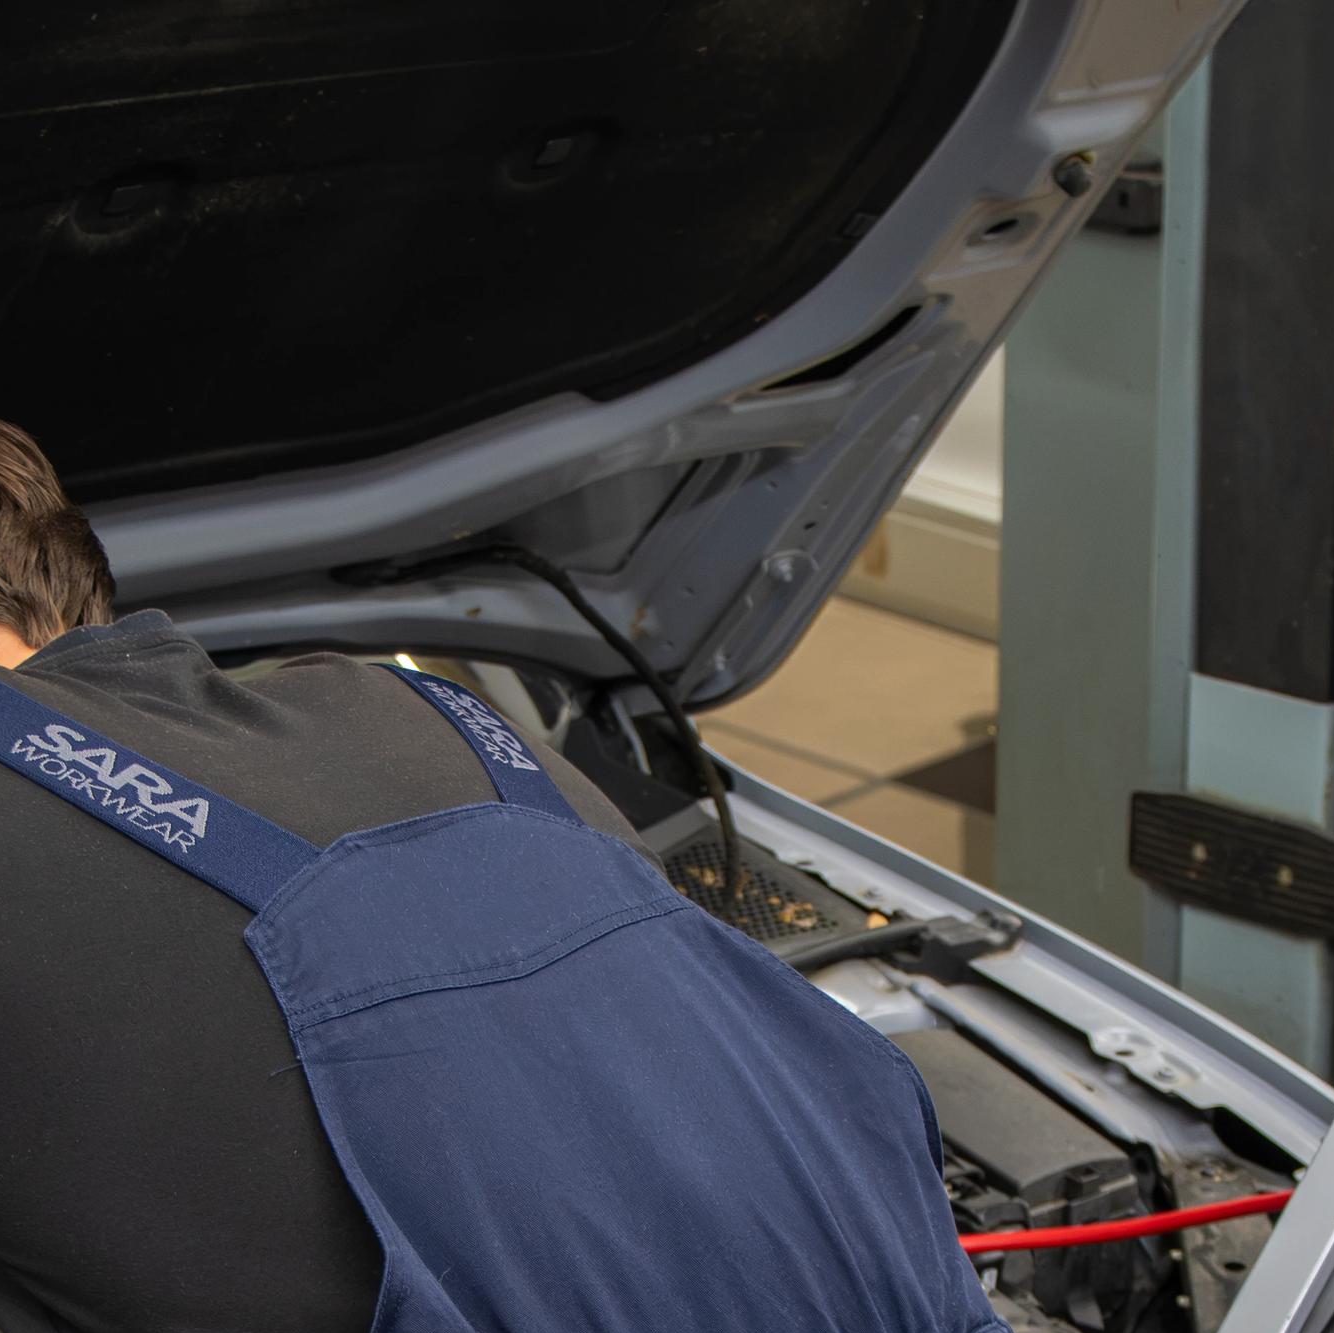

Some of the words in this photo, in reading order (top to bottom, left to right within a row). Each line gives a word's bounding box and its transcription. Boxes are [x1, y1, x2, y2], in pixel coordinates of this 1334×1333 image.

[26, 724, 209, 838] SARA
[442, 686, 539, 771] SARA
[11, 739, 195, 853] WORKWEAR
